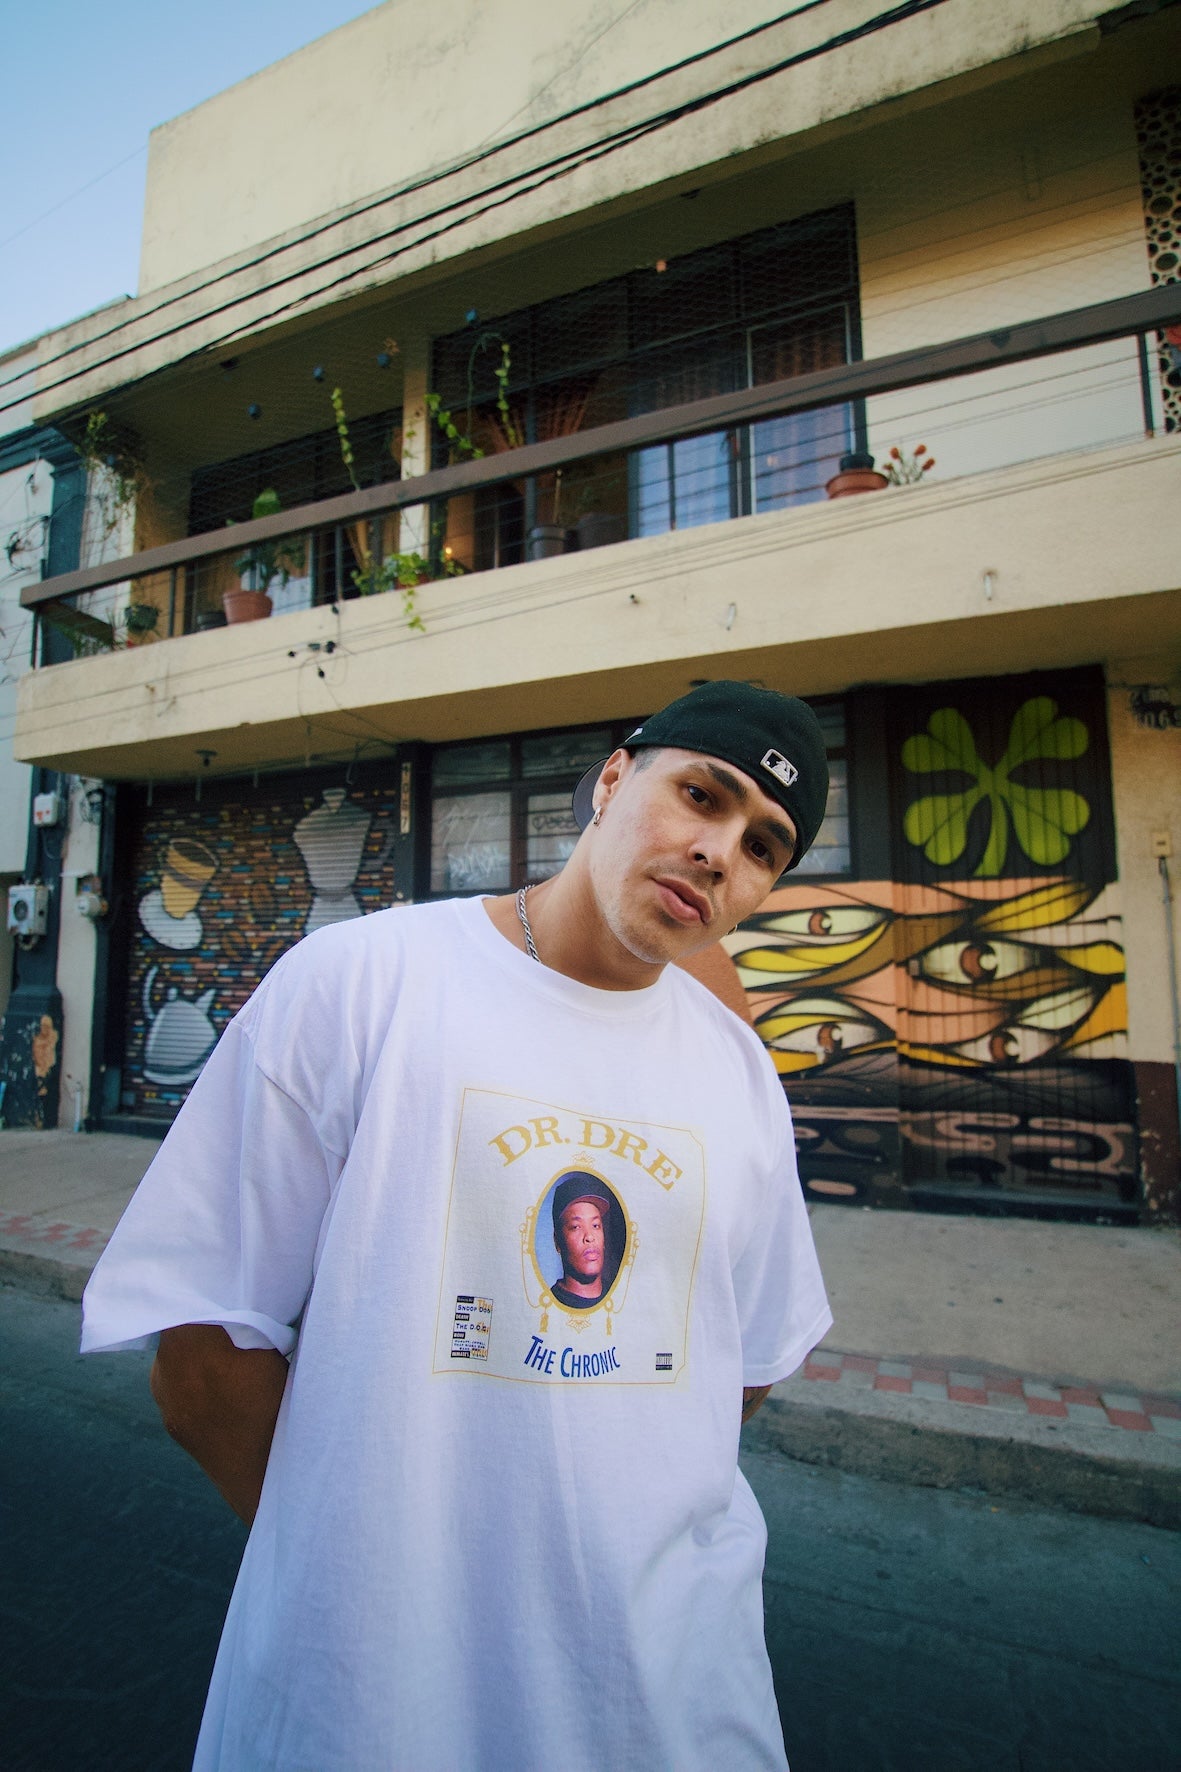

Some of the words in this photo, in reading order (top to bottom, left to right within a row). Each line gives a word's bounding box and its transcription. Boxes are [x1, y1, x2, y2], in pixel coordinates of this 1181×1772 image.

[488, 1116, 570, 1167] DR.
[577, 1119, 684, 1191] DRE
[457, 1304, 477, 1312] SNOOP
